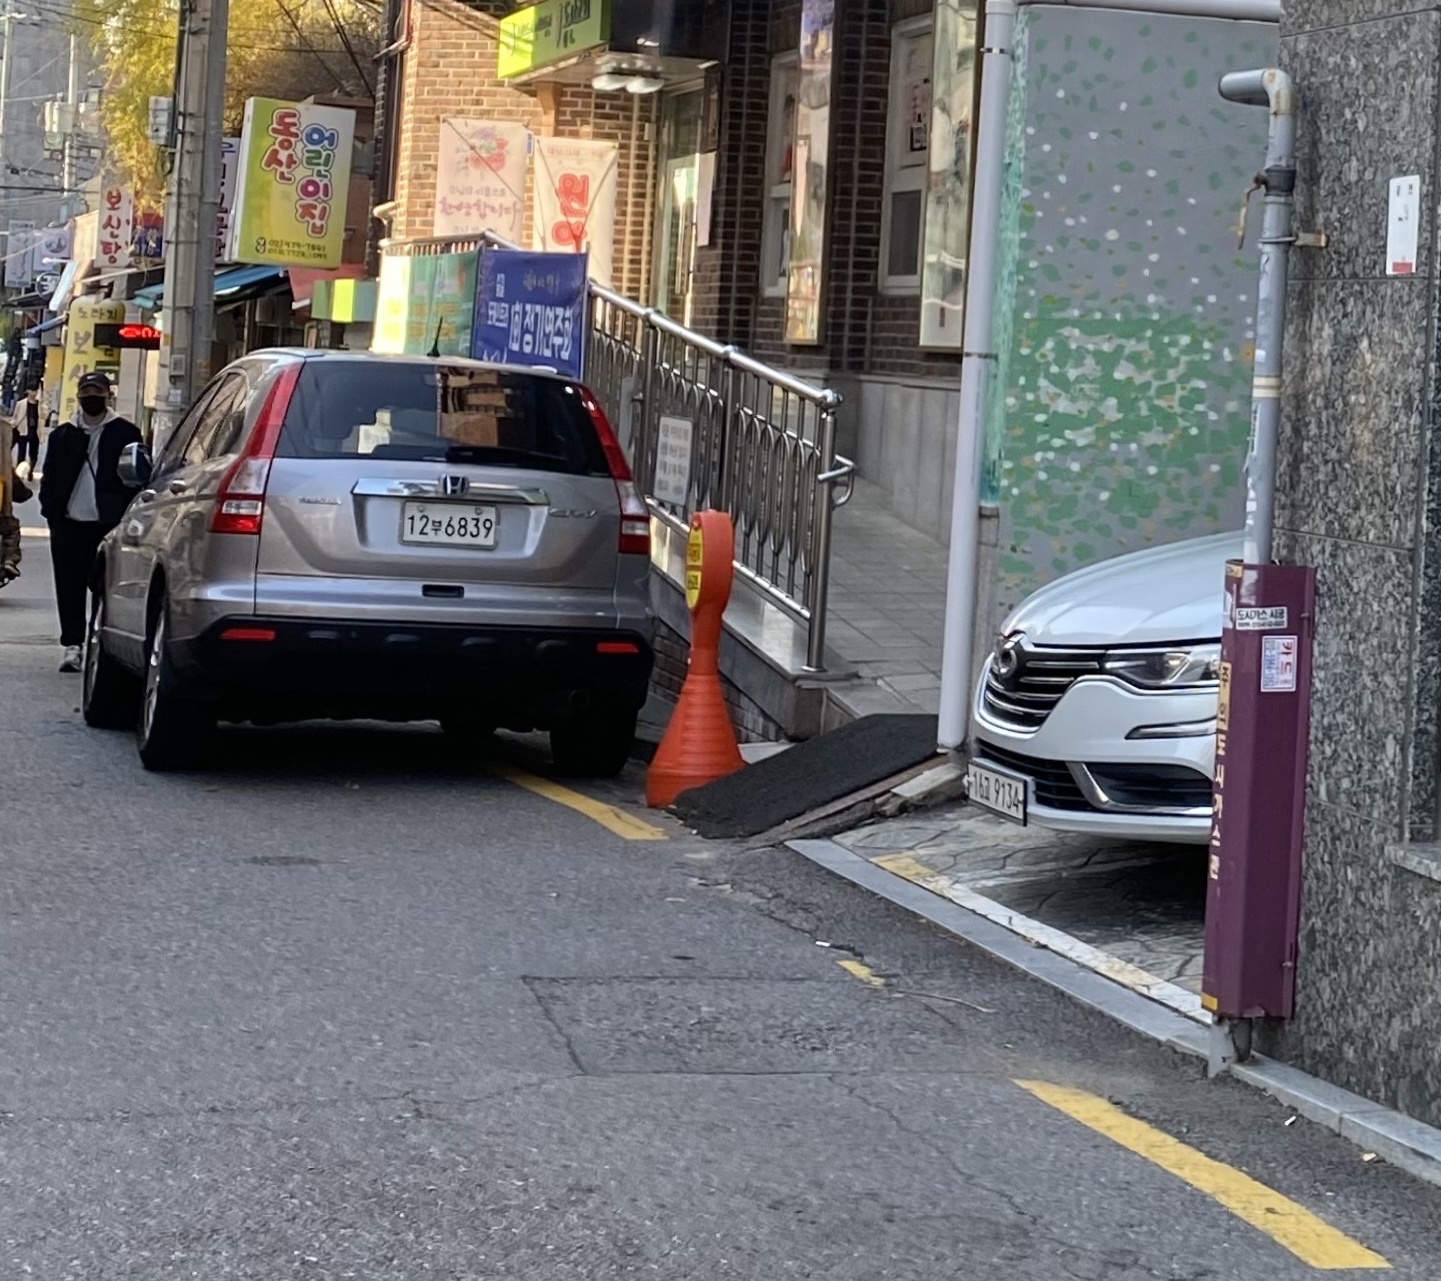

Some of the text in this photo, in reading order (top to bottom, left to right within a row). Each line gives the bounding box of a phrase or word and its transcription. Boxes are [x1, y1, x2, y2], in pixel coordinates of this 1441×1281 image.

[262, 110, 299, 183] 동산
[298, 126, 336, 235] 어린이집
[100, 189, 122, 265] 보신탕
[407, 514, 494, 539] 12부6839
